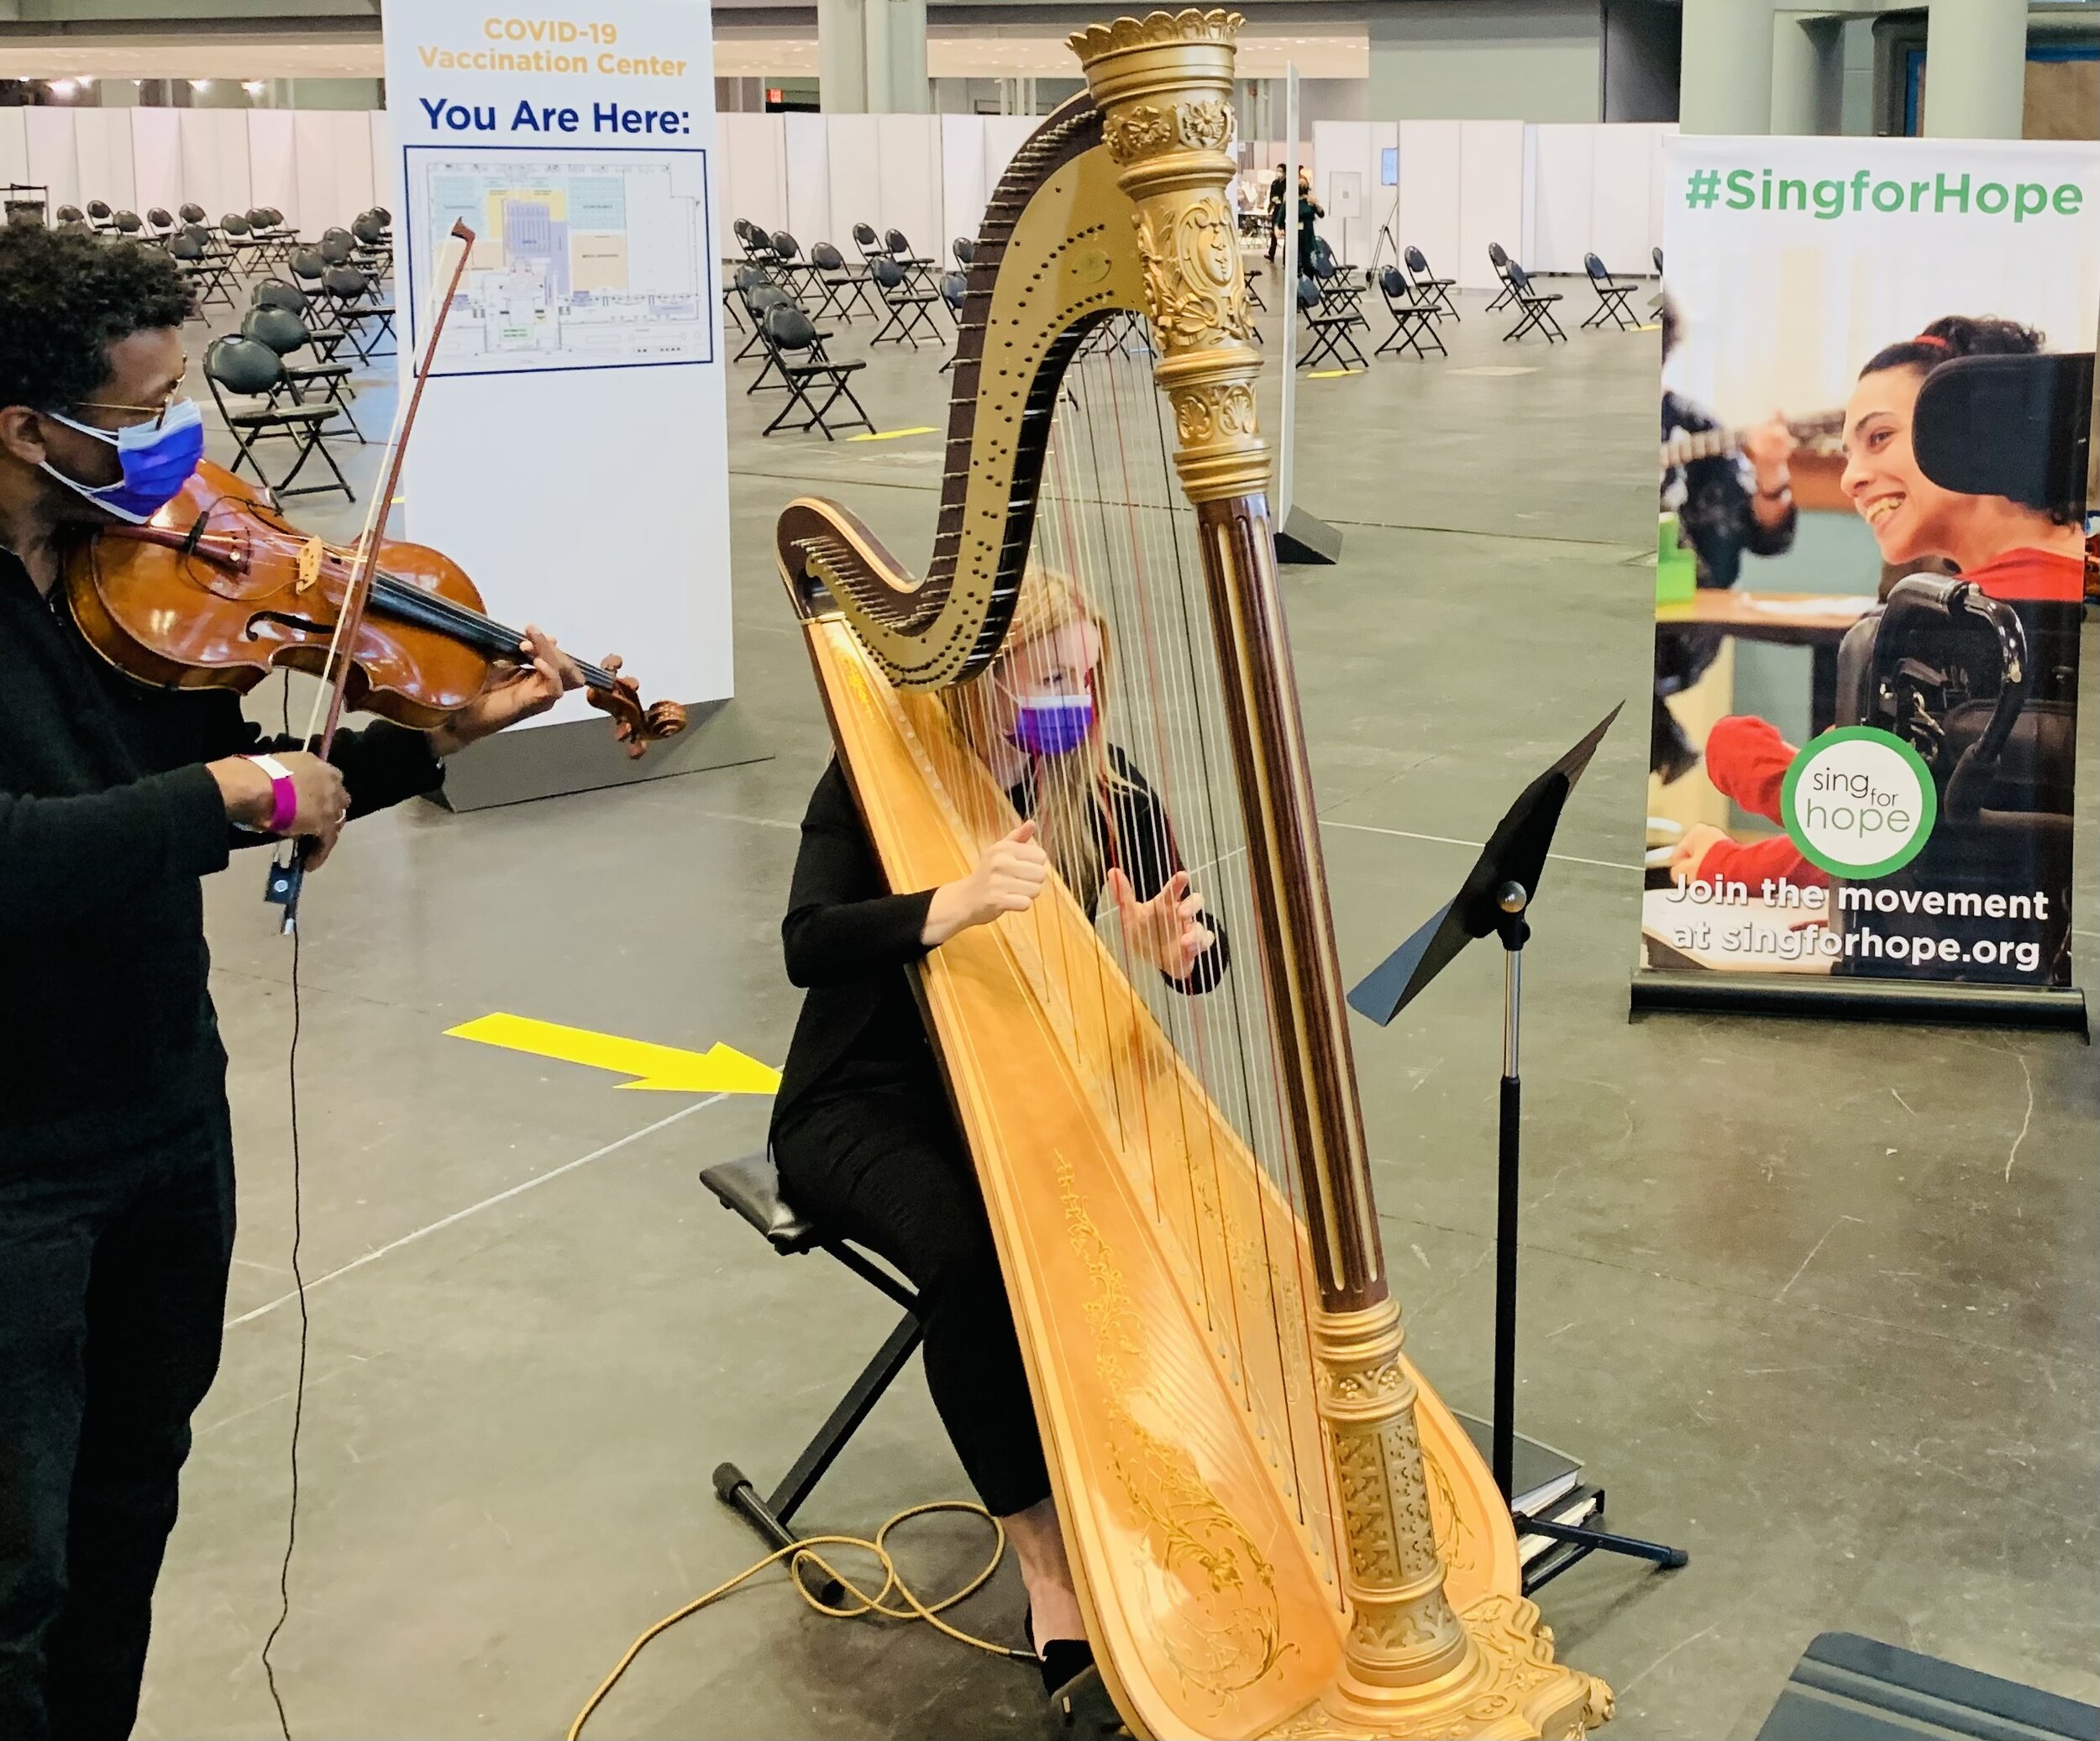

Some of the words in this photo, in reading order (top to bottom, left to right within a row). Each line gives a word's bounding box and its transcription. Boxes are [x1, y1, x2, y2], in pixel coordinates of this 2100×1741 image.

[485, 18, 617, 45] COVID-19
[418, 45, 588, 74] Vaccination
[597, 54, 687, 76] Center
[420, 98, 496, 131] You
[512, 101, 579, 132] Are
[594, 102, 690, 134] Here:
[1685, 169, 2082, 223] #SingforHope
[1813, 768, 1870, 798] sing
[1870, 788, 1898, 807] for
[1807, 799, 1910, 837] hope
[1667, 873, 1748, 906] Join
[1762, 877, 1824, 909] the
[1839, 887, 2049, 920] movement
[1672, 925, 1709, 949] at
[1721, 926, 2040, 970] singforhope.org
